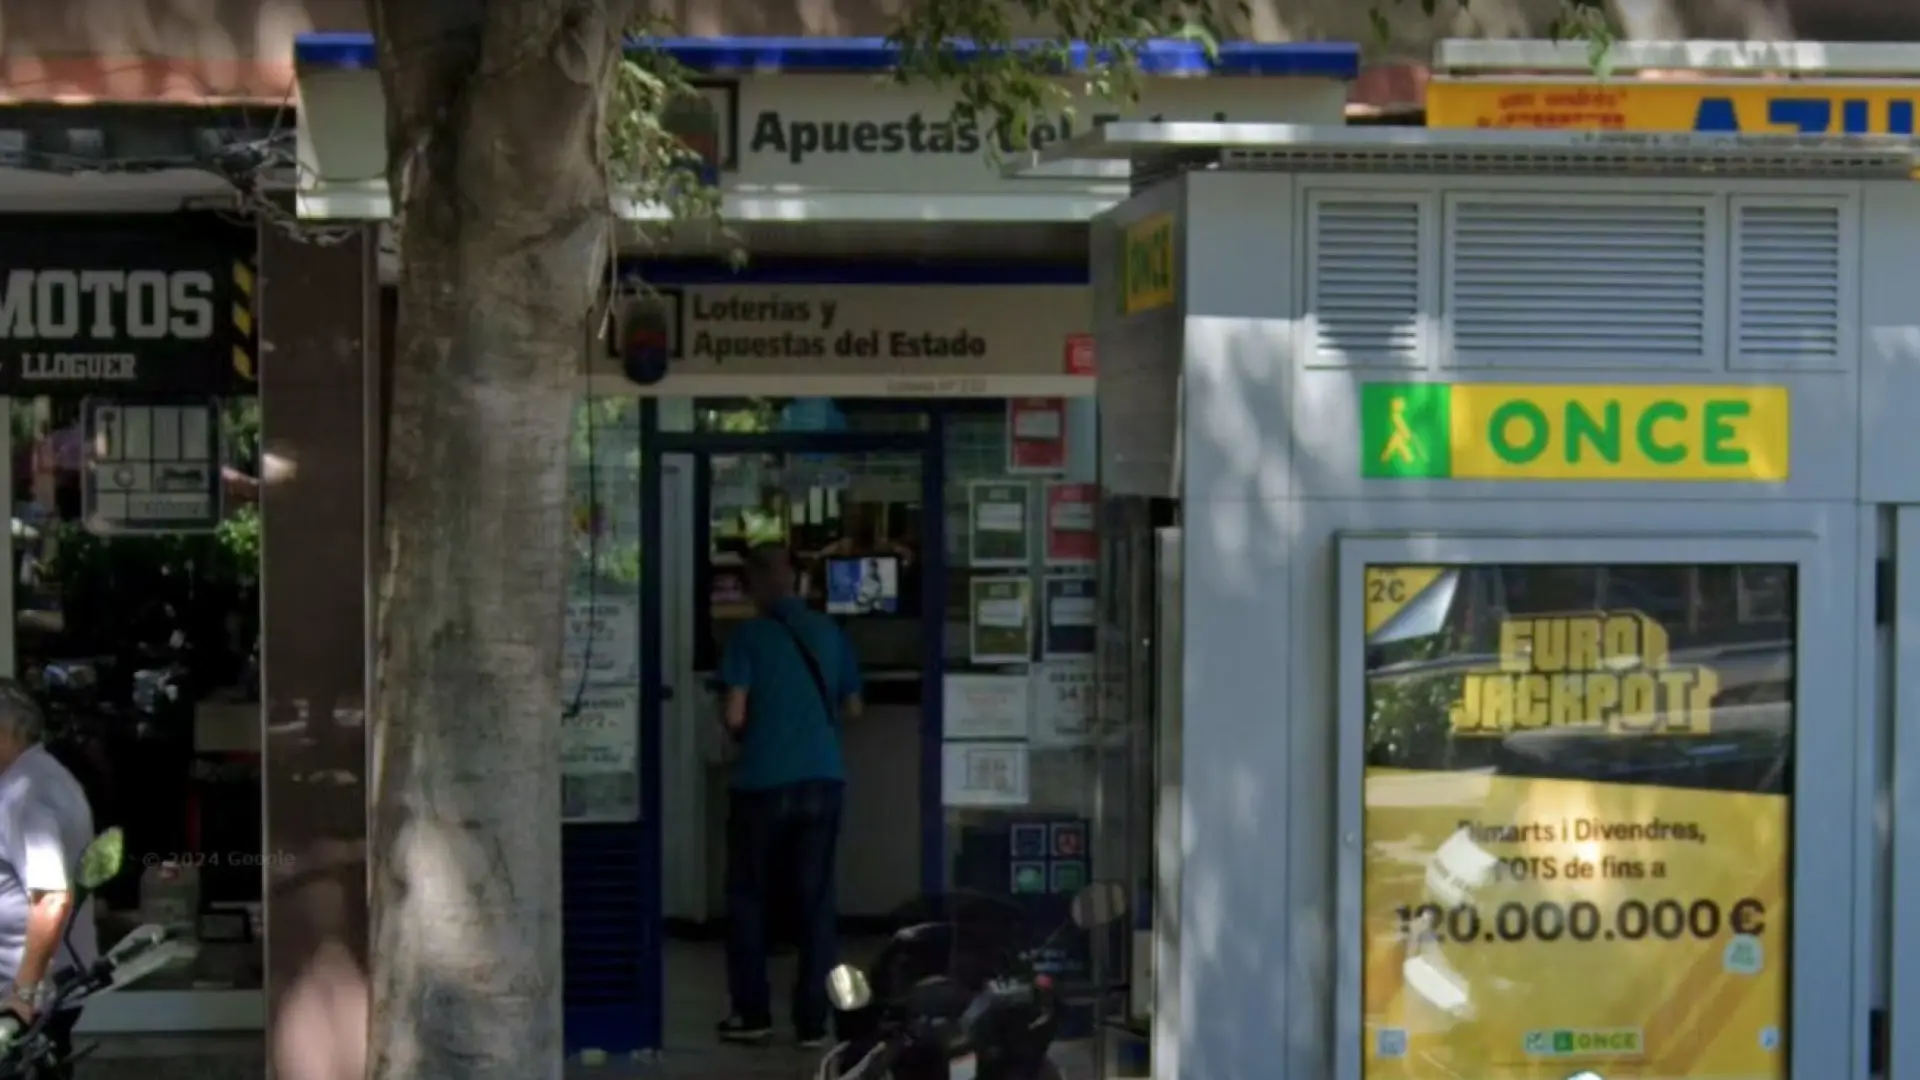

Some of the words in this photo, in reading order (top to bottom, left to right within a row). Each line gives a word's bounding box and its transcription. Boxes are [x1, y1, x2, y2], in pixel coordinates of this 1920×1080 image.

[751, 109, 979, 164] Apuestas
[819, 299, 837, 329] y
[692, 329, 826, 364] Apuestas
[833, 328, 880, 358] del
[888, 327, 987, 358] Estado
[21, 352, 137, 380] LLOGUER
[1486, 400, 1752, 466] ONCE
[1499, 612, 1652, 672] EURO
[1452, 669, 1706, 735] JACKPOT
[1560, 818, 1569, 842] i
[1574, 817, 1707, 844] Divendres,
[1563, 854, 1594, 879] de
[1601, 854, 1645, 879] fins
[1649, 859, 1667, 879] a
[1577, 1032, 1638, 1051] ONCE
